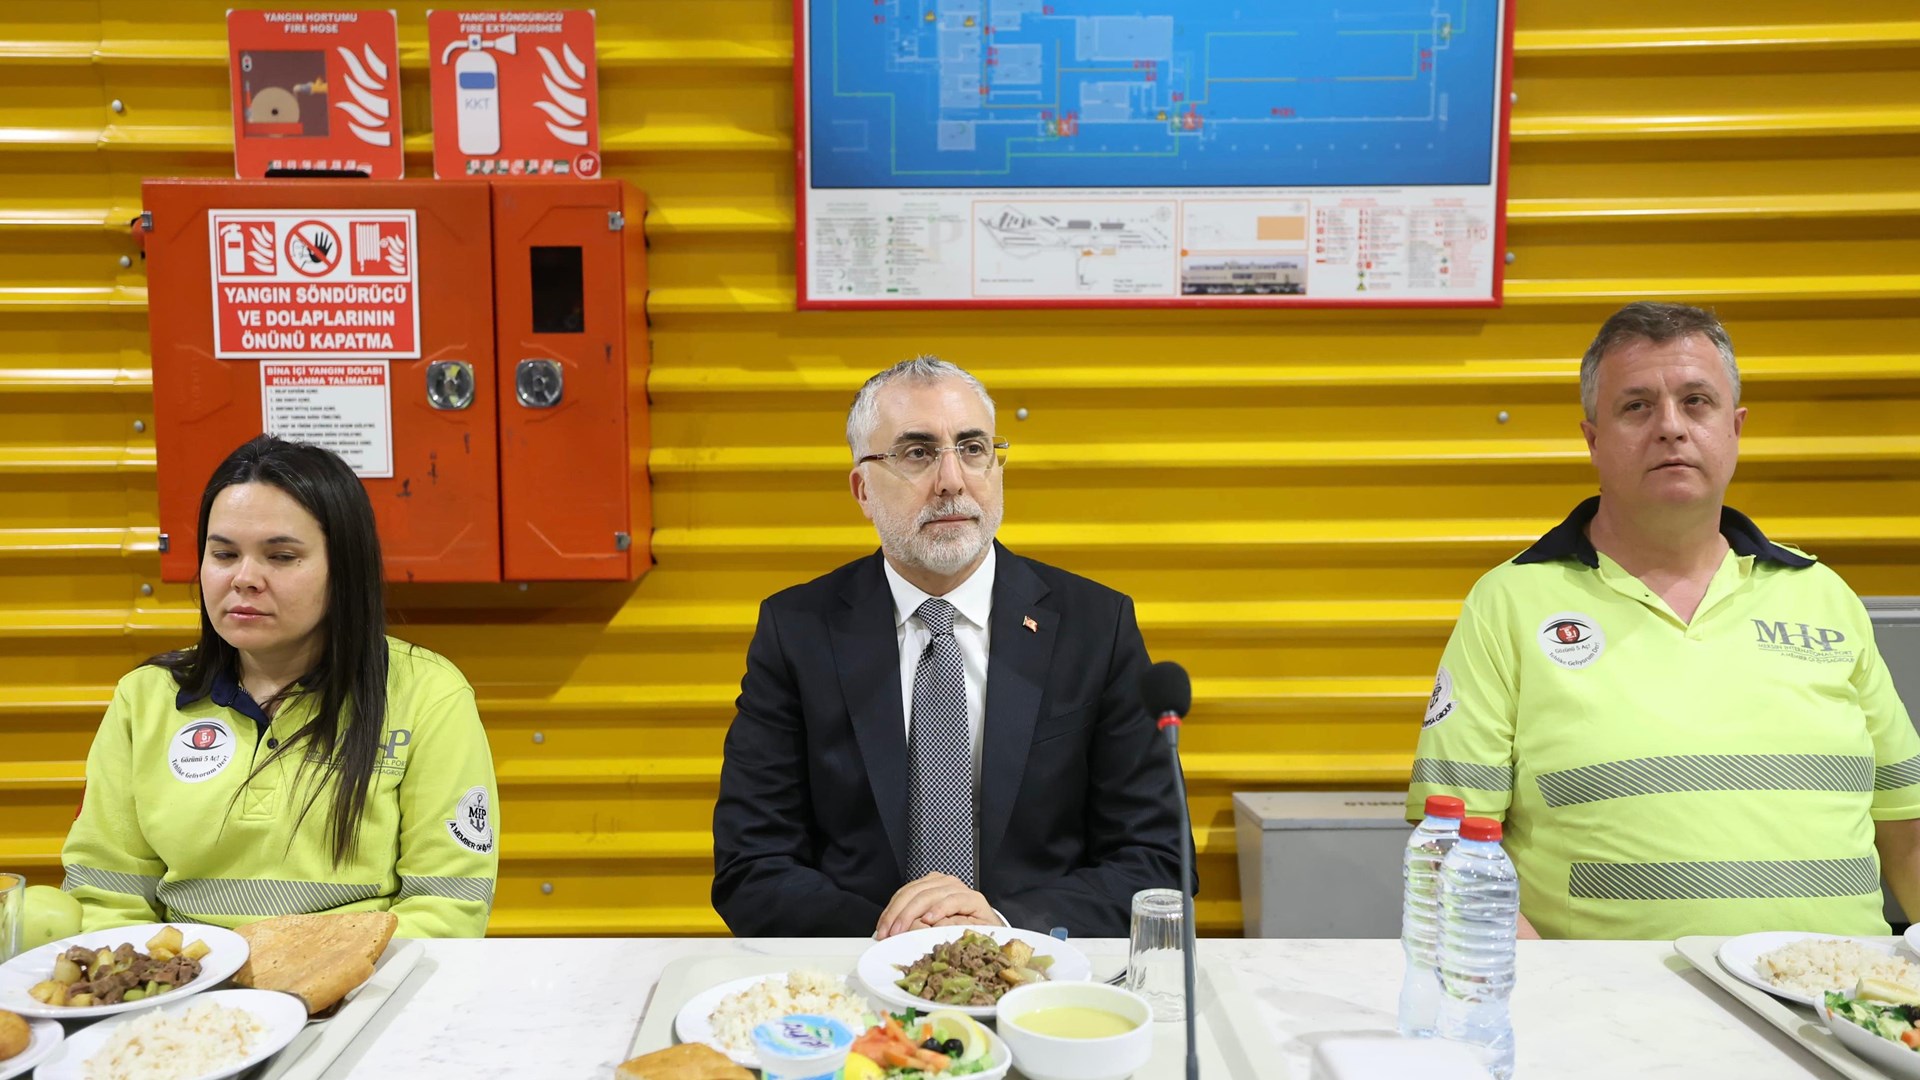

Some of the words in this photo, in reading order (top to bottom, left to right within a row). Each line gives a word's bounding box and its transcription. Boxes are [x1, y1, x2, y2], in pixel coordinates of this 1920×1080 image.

[263, 12, 303, 22] YANGIN
[305, 12, 358, 22] HORTUMU
[458, 12, 497, 22] YANGIN
[284, 23, 307, 33] FIRE
[310, 23, 339, 33] HOSE
[460, 23, 483, 33] FIRE
[485, 23, 562, 33] EXTINGUISHER
[465, 97, 490, 110] KKT
[579, 158, 594, 172] 87
[224, 287, 291, 303] YANGIN
[296, 284, 407, 304] SÖNDÜRÜCÜ
[238, 310, 261, 326] VE
[265, 310, 395, 326] DOLAPLARININ
[241, 330, 305, 349] ÖNÜNÜ
[310, 332, 394, 349] KAPATMA
[266, 366, 290, 375] BİNA
[308, 366, 345, 375] YANGIN
[346, 366, 383, 375] DOLABI
[273, 376, 326, 385] KULLANMA
[1751, 619, 1845, 651] MIP
